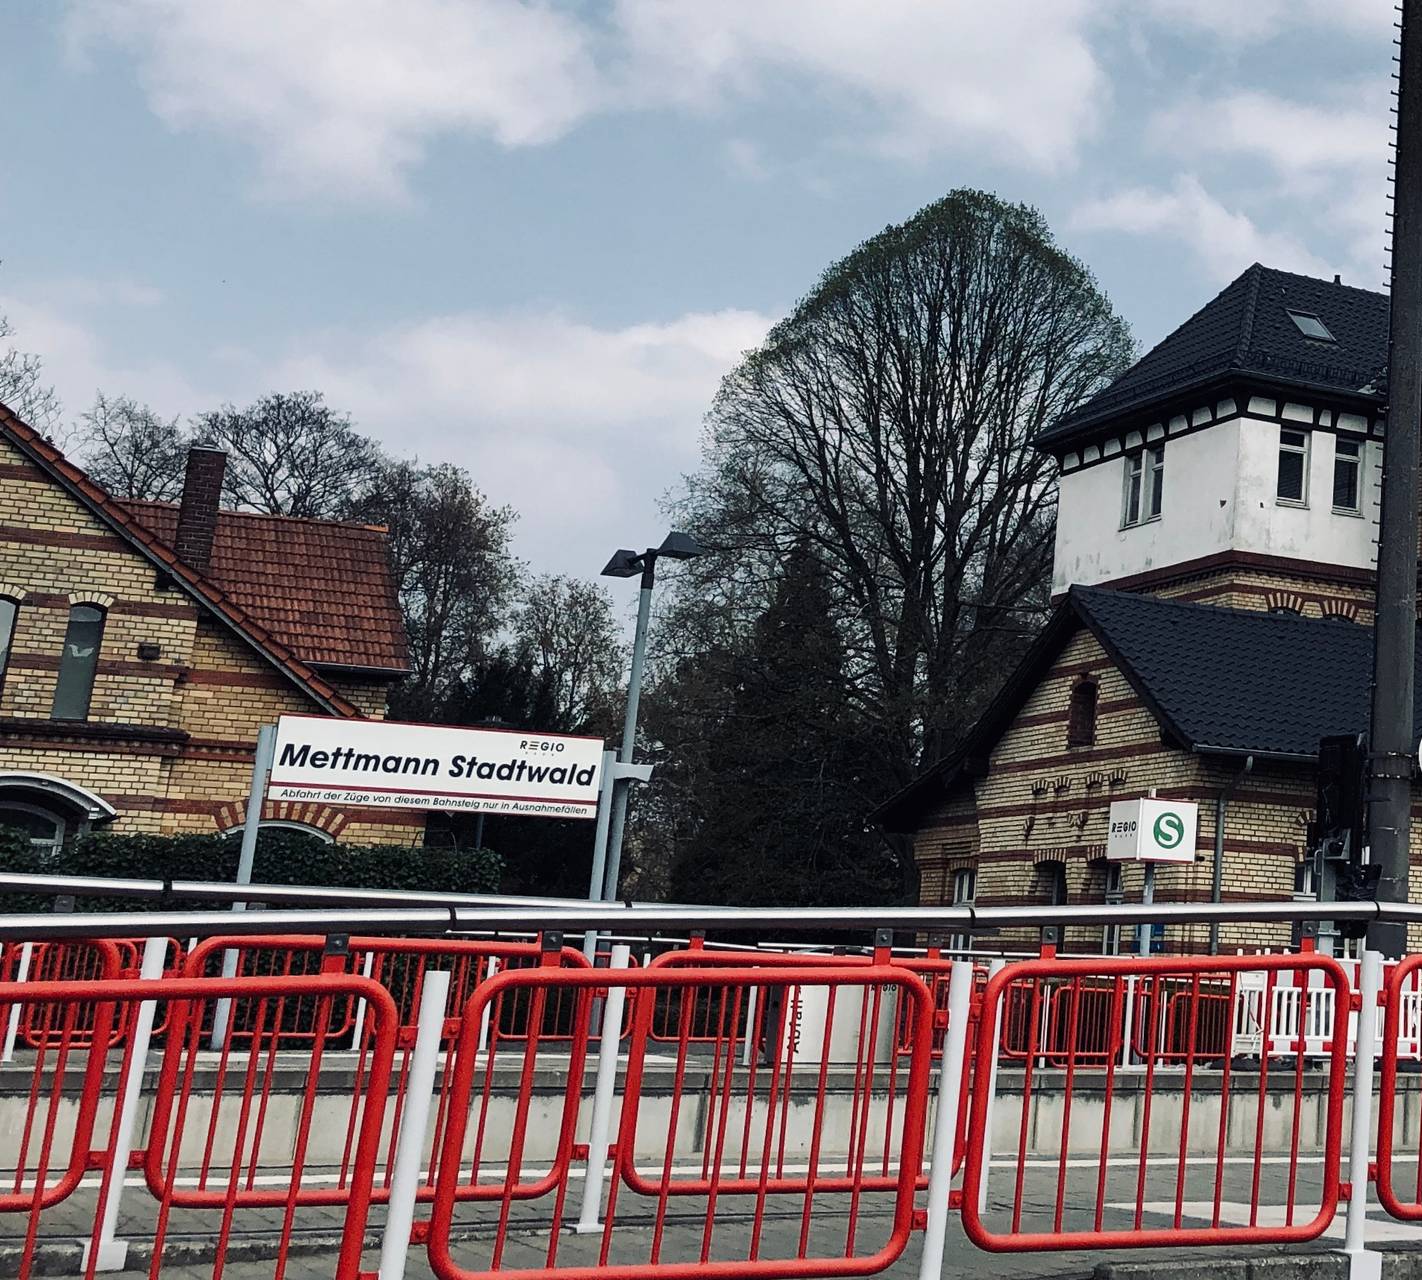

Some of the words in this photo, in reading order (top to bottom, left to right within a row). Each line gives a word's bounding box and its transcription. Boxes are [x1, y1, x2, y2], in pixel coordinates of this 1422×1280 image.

[520, 740, 565, 752] REGIO
[278, 743, 440, 776] Mettmann
[448, 755, 597, 787] Stadtwald
[280, 789, 321, 799] Abfahrt
[323, 791, 342, 800] der
[343, 792, 370, 803] Züge
[373, 795, 392, 803] von
[394, 796, 431, 805] diesem
[432, 797, 481, 809] Bahnsteig
[500, 802, 510, 810] in
[511, 803, 588, 814] Ausnahmefällen
[1111, 821, 1137, 833] REGIO
[870, 983, 897, 992] RGIO
